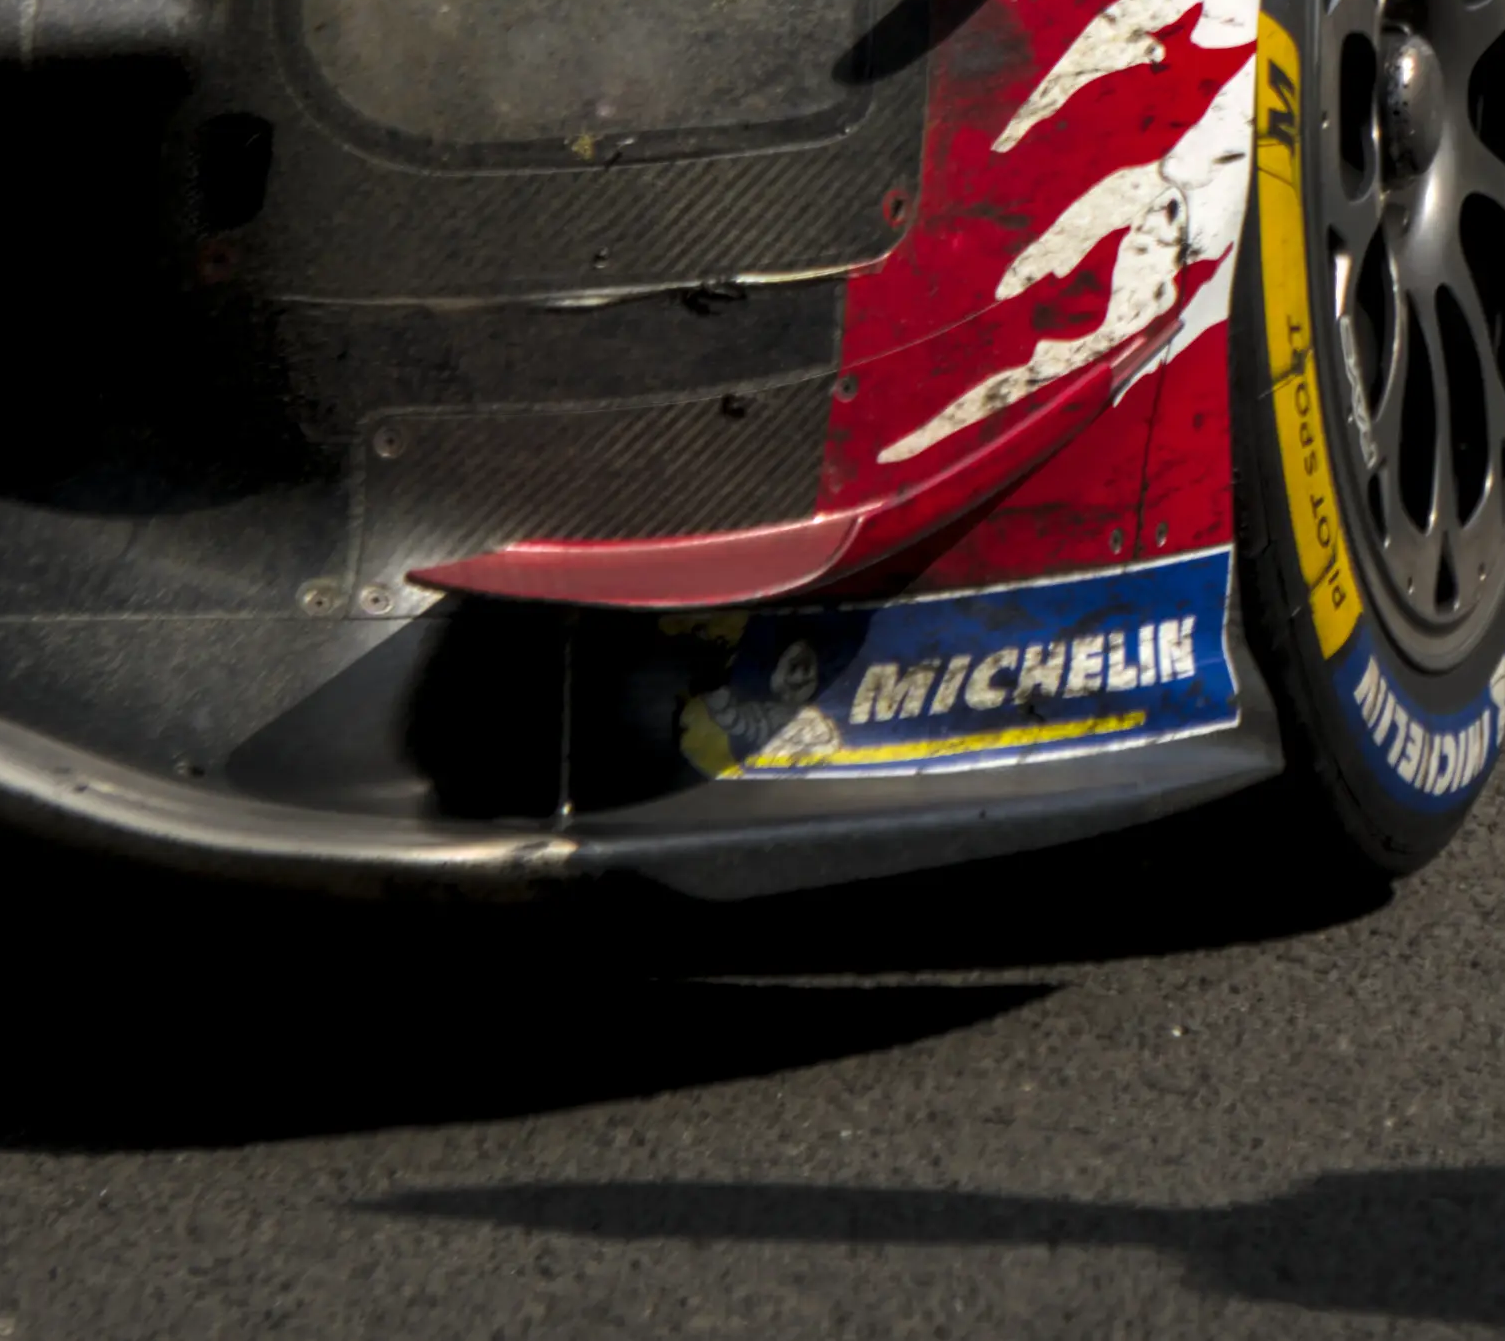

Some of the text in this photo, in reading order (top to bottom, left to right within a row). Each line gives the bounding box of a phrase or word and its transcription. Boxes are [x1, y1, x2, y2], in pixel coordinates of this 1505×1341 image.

[1286, 320, 1347, 611] PILOT SPORT
[851, 615, 1196, 725] MICHELIN
[1353, 654, 1491, 797] MICHELIN
